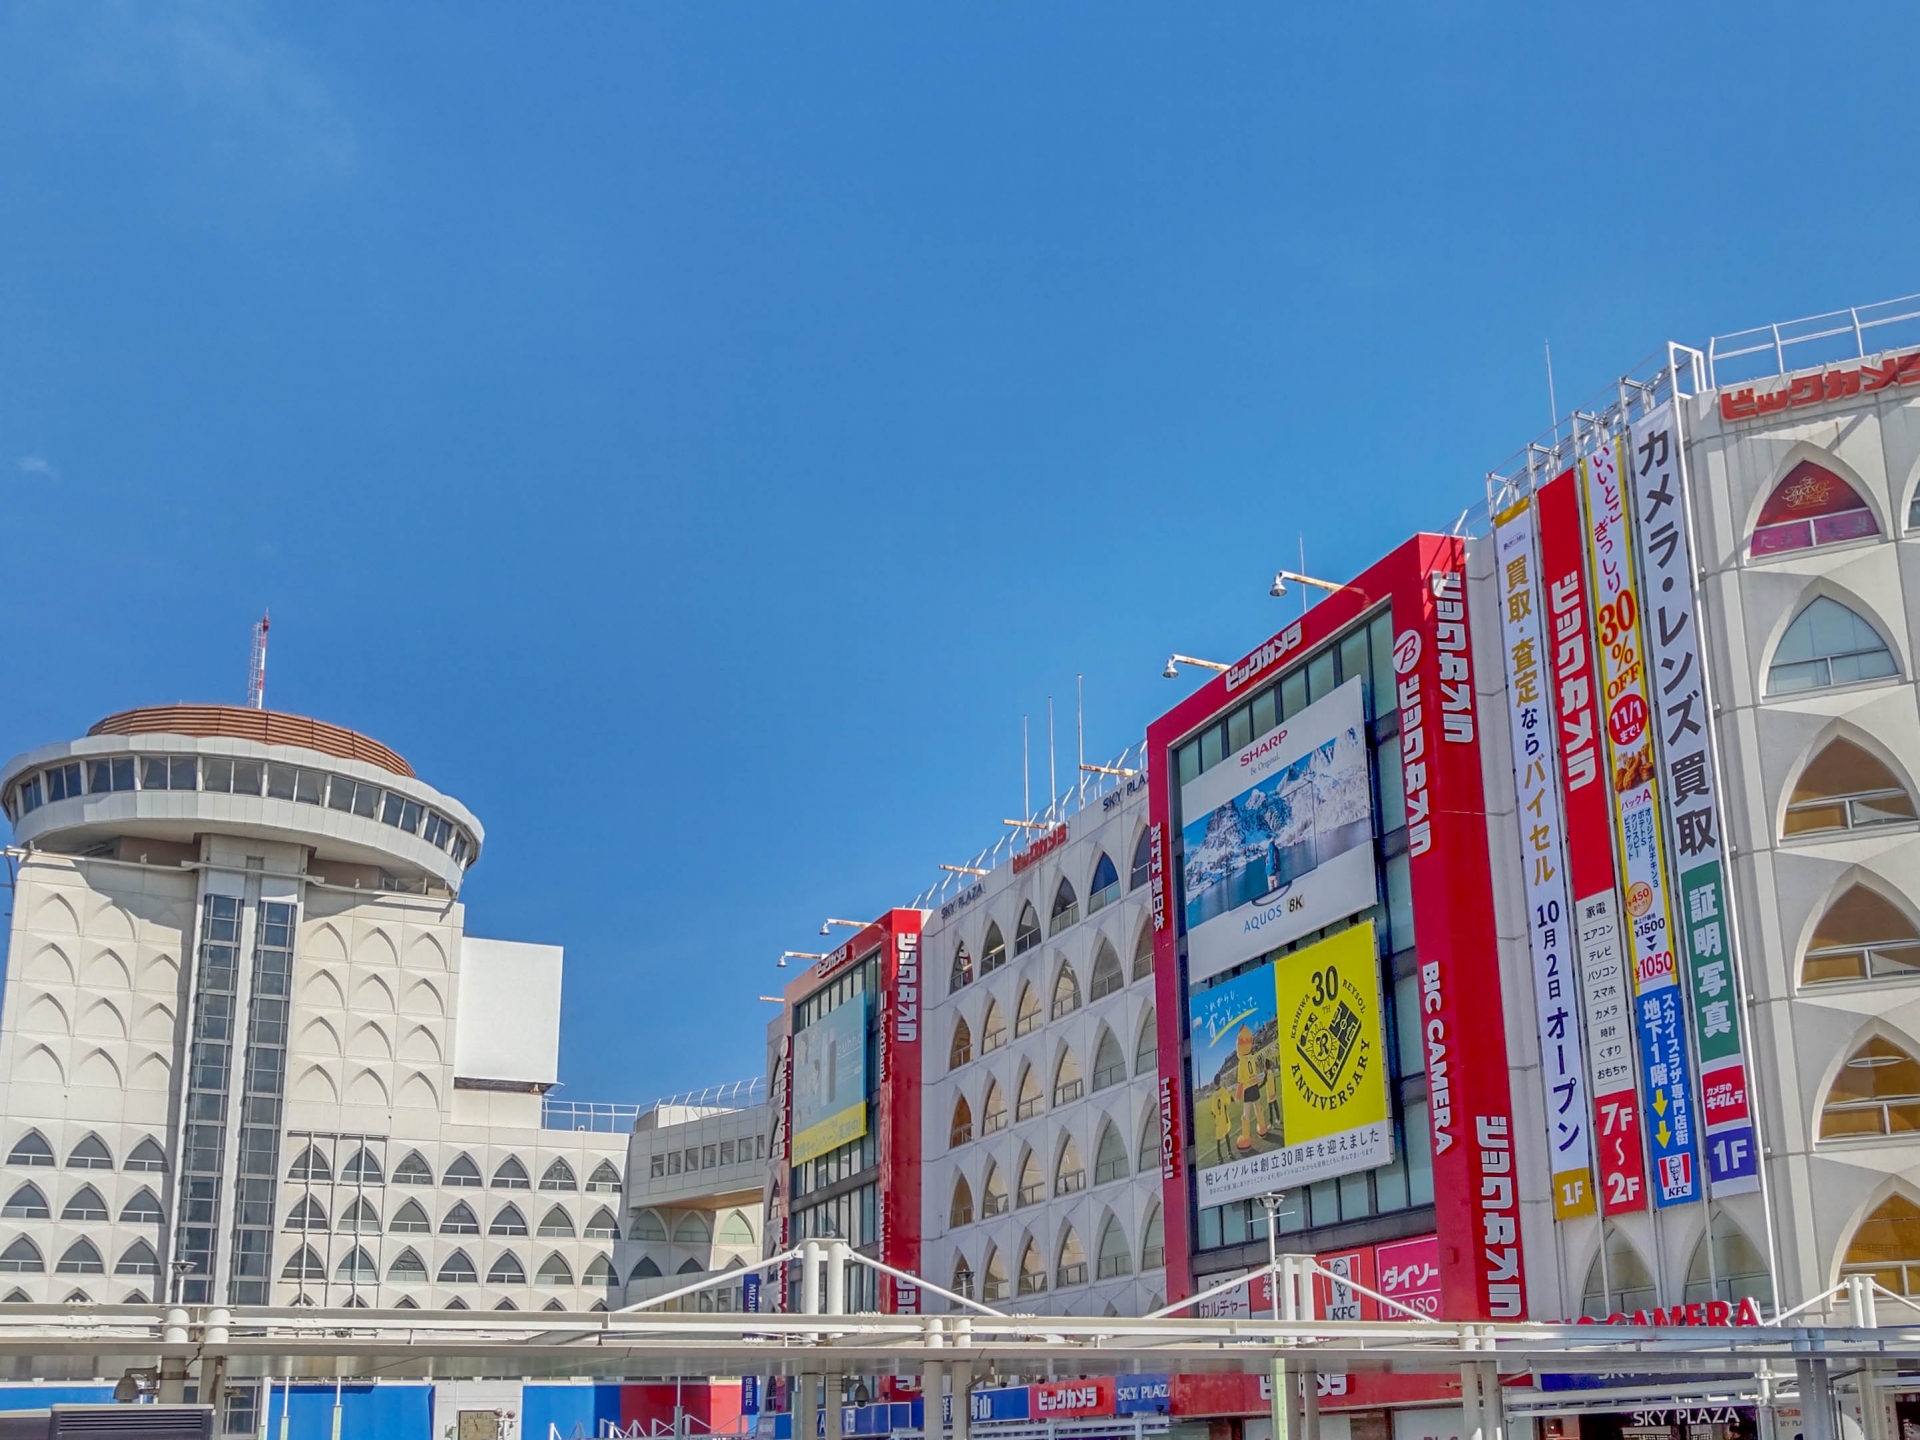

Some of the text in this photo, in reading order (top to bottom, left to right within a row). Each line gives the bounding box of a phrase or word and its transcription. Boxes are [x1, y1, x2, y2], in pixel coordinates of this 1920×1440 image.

[1226, 621, 1302, 692] ビックカメラ
[1432, 571, 1475, 743] ビックカメラ
[1638, 430, 1717, 857] カメラ・レンズ買取
[1551, 570, 1597, 792] ビックカメラ
[1607, 661, 1640, 699] OFF
[1611, 700, 1642, 730] 11/1
[1240, 730, 1288, 767] SHARP
[1399, 674, 1432, 858] ビックカメラ
[1103, 788, 1123, 812] SKY
[1012, 823, 1067, 875] ビックカメラ
[941, 883, 983, 920] SKY PLAZA
[1288, 895, 1304, 913] 8K
[1586, 901, 1606, 919] 家電
[1243, 906, 1283, 934] AQUOS
[1583, 925, 1614, 942] エアコン
[1589, 945, 1612, 962] テレビ
[1689, 882, 1732, 1039] 証明写真
[898, 933, 917, 1042] ビックカメラ
[1311, 965, 1339, 1007] 30
[1588, 966, 1618, 982] パソコン
[1342, 979, 1365, 1015] REYSOL
[1593, 985, 1616, 1000] スマホ
[1291, 993, 1311, 1040] KASHIWA
[1322, 1004, 1331, 1015] TH
[1595, 1004, 1618, 1020] カメラ
[880, 1014, 889, 1082] SoftBank
[1600, 1025, 1616, 1038] 時計
[1643, 997, 1669, 1089] 地下1階
[1422, 961, 1453, 1156] BIC CAMERA
[1599, 1045, 1622, 1059] くすり
[1291, 1038, 1370, 1111] ANNIVERSARY
[1597, 1064, 1628, 1080] おもちゃ
[1662, 993, 1688, 1146] スカイプラザ専門店街
[1707, 1083, 1732, 1097] カメラの
[1707, 1091, 1744, 1110] キタムラ
[1159, 1077, 1173, 1180] HITACHI
[1601, 1102, 1633, 1136] 7F
[1205, 1127, 1380, 1187] 柏レイソルは創立30周年を迎えました
[1713, 1139, 1747, 1173] 1F
[1562, 1181, 1583, 1206] 1F
[1607, 1172, 1640, 1205] 2F
[1667, 1185, 1689, 1198] KFC
[1476, 1116, 1522, 1318] ビックカメラ
[1382, 1262, 1438, 1292] ダイソー
[1200, 1299, 1247, 1319] カルチャー
[1332, 1305, 1356, 1320] KFC
[1038, 1386, 1097, 1411] ビックカメラ
[1117, 1384, 1170, 1402] SKY PLAZ
[1632, 1407, 1740, 1427] SKY PLAZA
